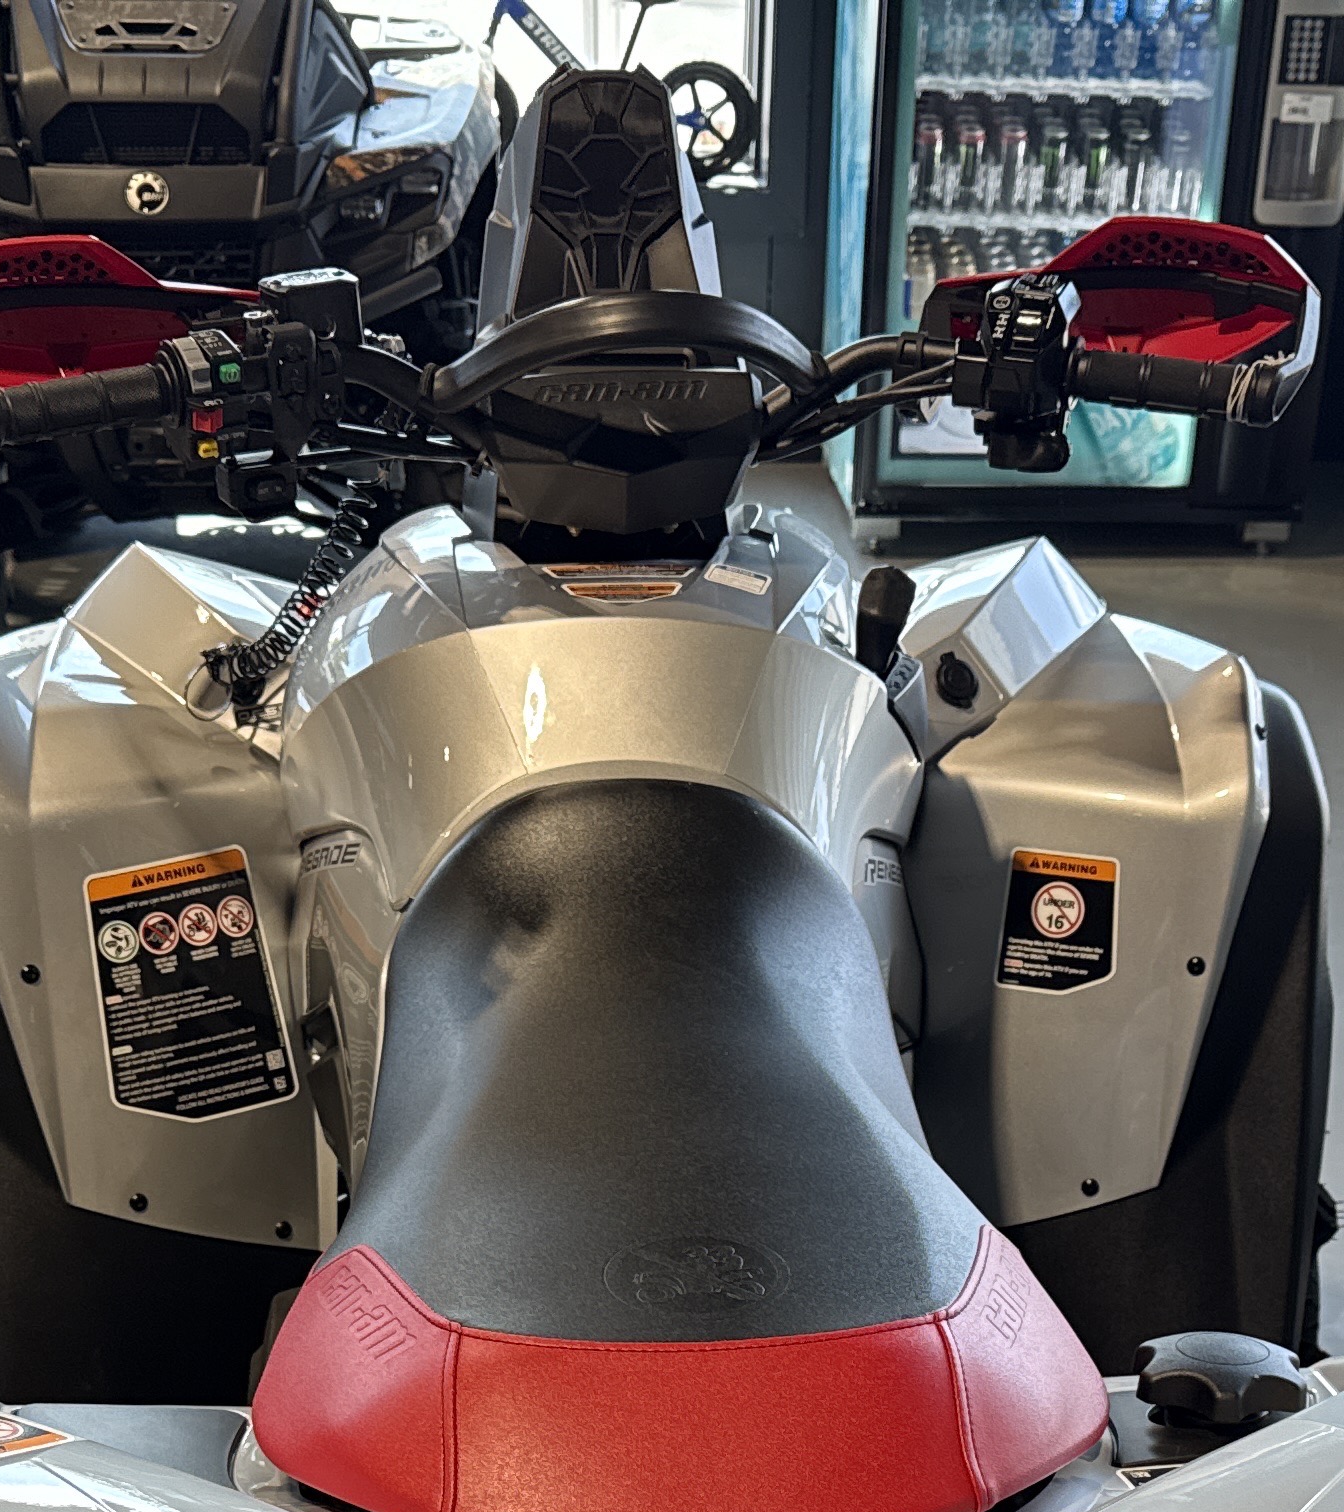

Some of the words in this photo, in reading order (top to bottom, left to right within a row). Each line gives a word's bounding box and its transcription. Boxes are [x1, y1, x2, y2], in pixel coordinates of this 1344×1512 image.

[534, 379, 709, 403] can-am
[143, 863, 207, 885] WARNING
[1041, 859, 1098, 876] WARNING
[1042, 897, 1076, 910] UNDER
[1046, 913, 1065, 930] 16
[318, 1264, 418, 1364] can-am
